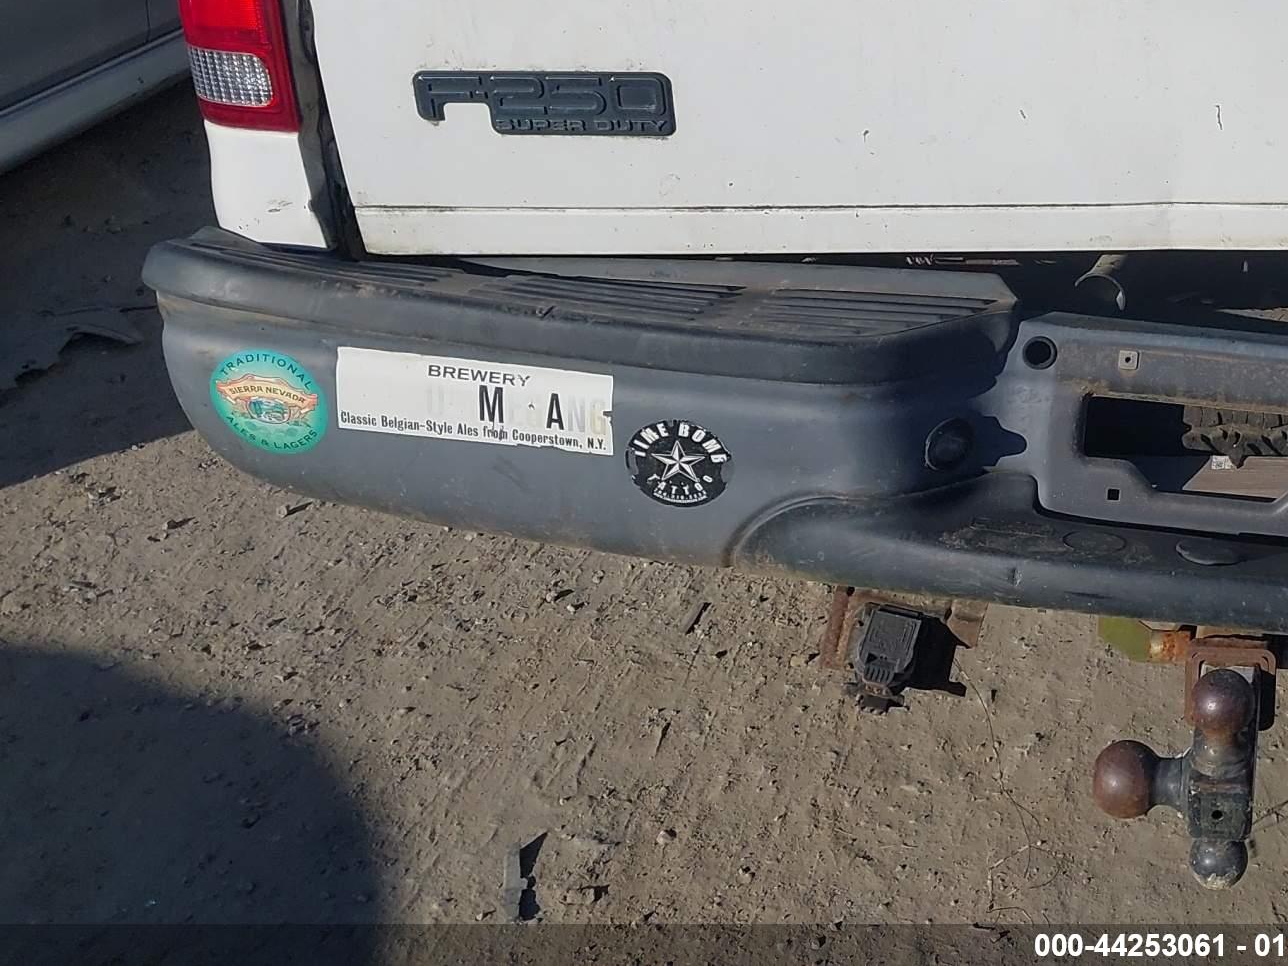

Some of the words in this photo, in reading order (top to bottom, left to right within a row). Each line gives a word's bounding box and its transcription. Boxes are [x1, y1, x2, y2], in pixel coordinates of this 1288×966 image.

[496, 119, 587, 133] SUPER
[593, 119, 669, 133] DUTY
[220, 353, 314, 391] TRADITIONAL
[427, 364, 531, 387] BREWERY
[229, 385, 264, 395] SIERRA
[265, 386, 307, 404] NEVADA
[225, 415, 257, 441] ALES
[273, 429, 318, 450] LAGERS
[340, 410, 378, 427] Classic
[380, 414, 453, 435] Belgian-Style
[457, 422, 479, 437] Ales
[483, 425, 508, 441] from
[512, 428, 583, 449] Cooperstown,
[587, 436, 607, 451] N.Y.
[678, 421, 729, 464] BOMB
